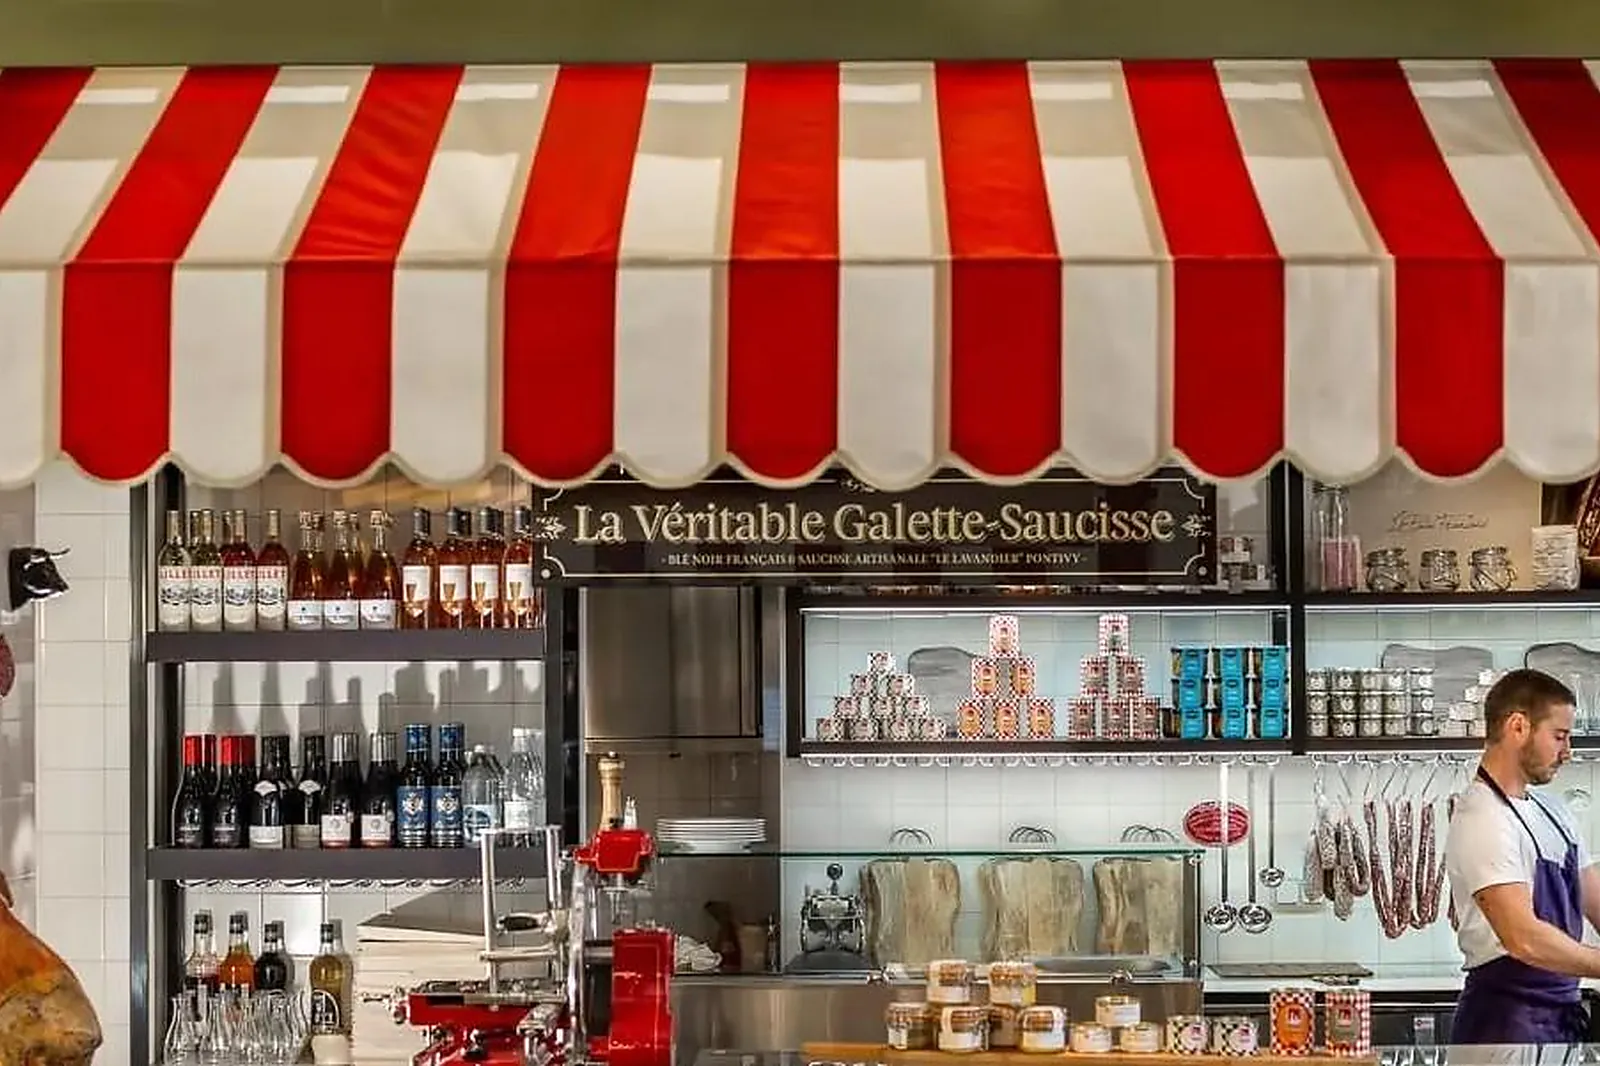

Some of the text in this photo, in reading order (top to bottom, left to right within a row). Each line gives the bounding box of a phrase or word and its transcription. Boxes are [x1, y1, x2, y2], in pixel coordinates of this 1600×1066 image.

[573, 501, 1175, 544] La Véritable Galette-Saucisse
[692, 553, 724, 565] NOIR
[726, 552, 786, 567] FRANÇAIS
[797, 553, 852, 565] SAUCISSE
[855, 553, 927, 565] ARTISANALE
